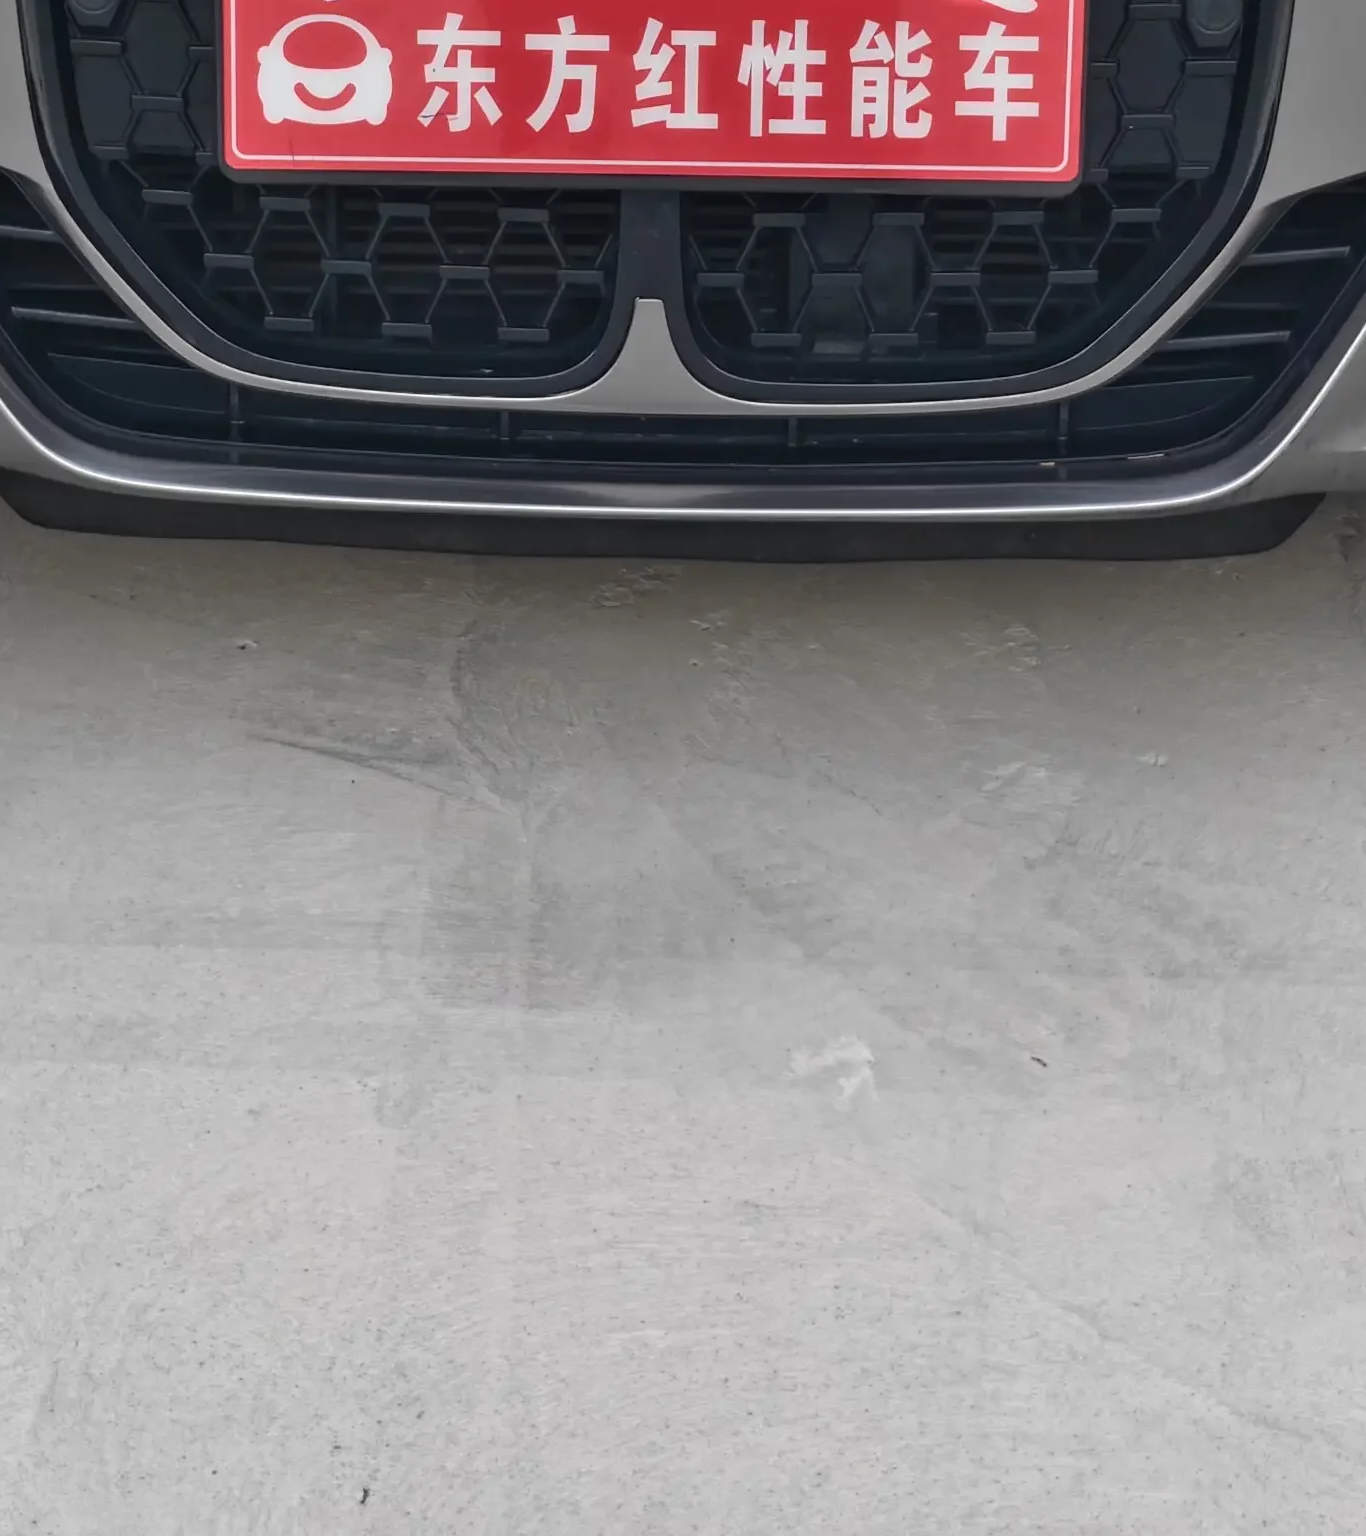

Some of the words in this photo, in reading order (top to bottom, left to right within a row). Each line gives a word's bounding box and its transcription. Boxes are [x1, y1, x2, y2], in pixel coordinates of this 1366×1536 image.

[416, 13, 1039, 141] 东方红性能车
